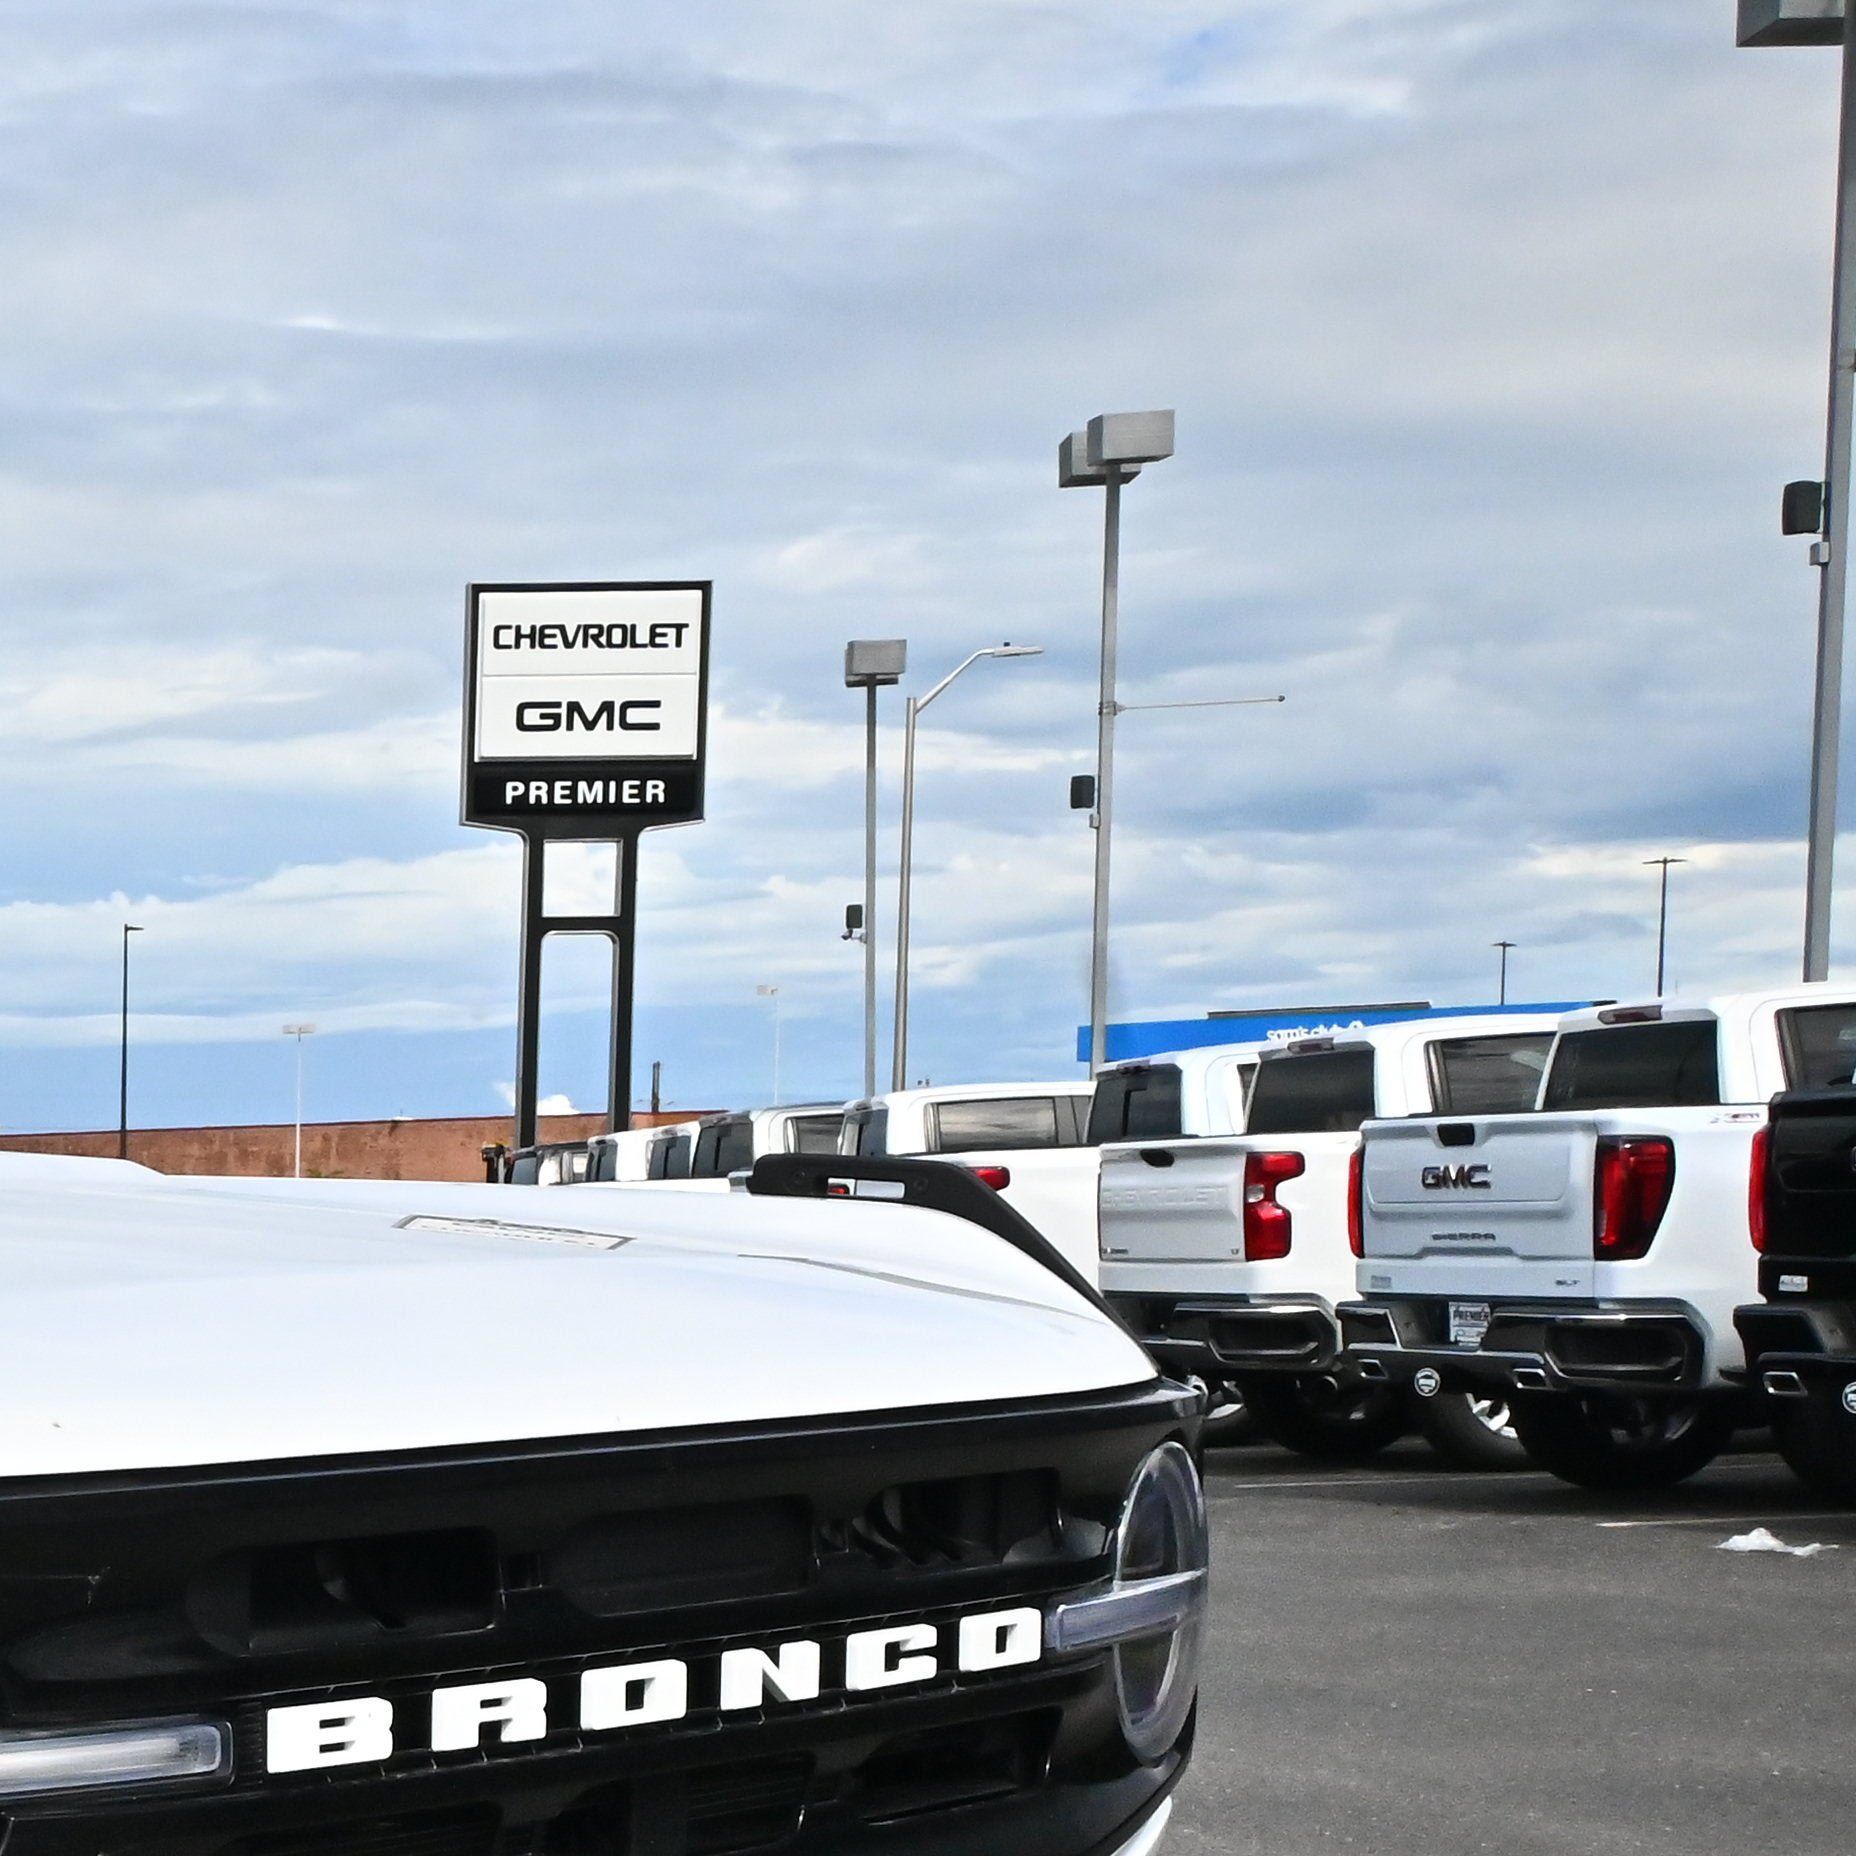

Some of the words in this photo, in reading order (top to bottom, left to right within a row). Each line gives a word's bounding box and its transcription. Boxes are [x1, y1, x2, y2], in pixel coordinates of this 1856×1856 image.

[493, 623, 690, 650] CHEVROLET
[515, 700, 661, 732] GMC
[505, 780, 666, 804] PREMIER
[1421, 1164, 1492, 1189] GMC
[1432, 1232, 1496, 1242] SIERRA
[266, 1606, 1043, 1773] BRONCO
